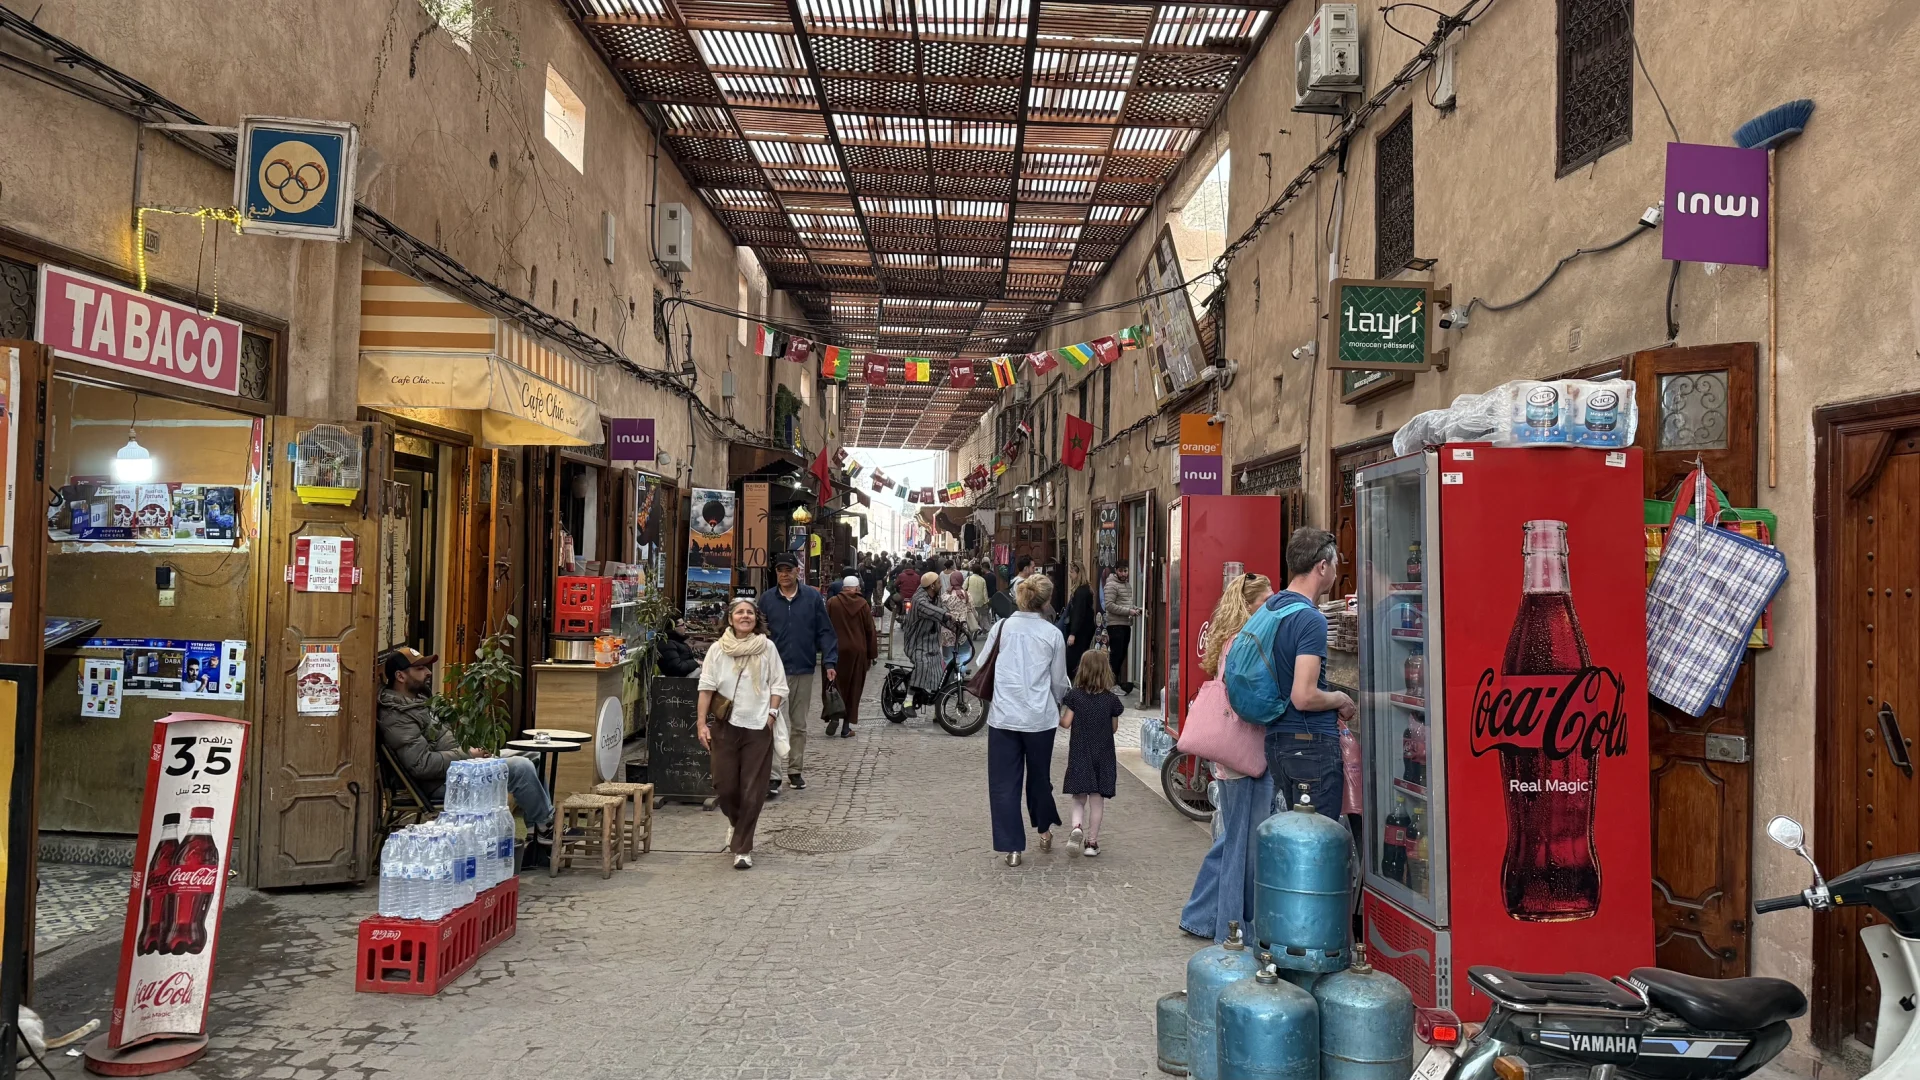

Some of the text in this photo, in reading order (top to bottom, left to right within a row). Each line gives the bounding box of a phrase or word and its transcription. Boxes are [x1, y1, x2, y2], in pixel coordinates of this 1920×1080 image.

[1677, 191, 1760, 218] inwi
[65, 282, 223, 380] TABACO
[412, 375, 430, 384] Chic
[546, 393, 565, 422] Chic
[616, 434, 650, 444] inwi
[1184, 471, 1217, 480] inwi
[744, 548, 766, 566] 70
[309, 575, 327, 583] Fumer
[1470, 666, 1628, 760] Coca-Cola
[165, 736, 232, 780] 3,5
[192, 784, 210, 794] 25
[1510, 779, 1588, 794] Real Magic
[168, 868, 218, 886] Coca-Cola
[370, 929, 401, 940] Coca-Cola
[1571, 1035, 1637, 1054] YAMAHA
